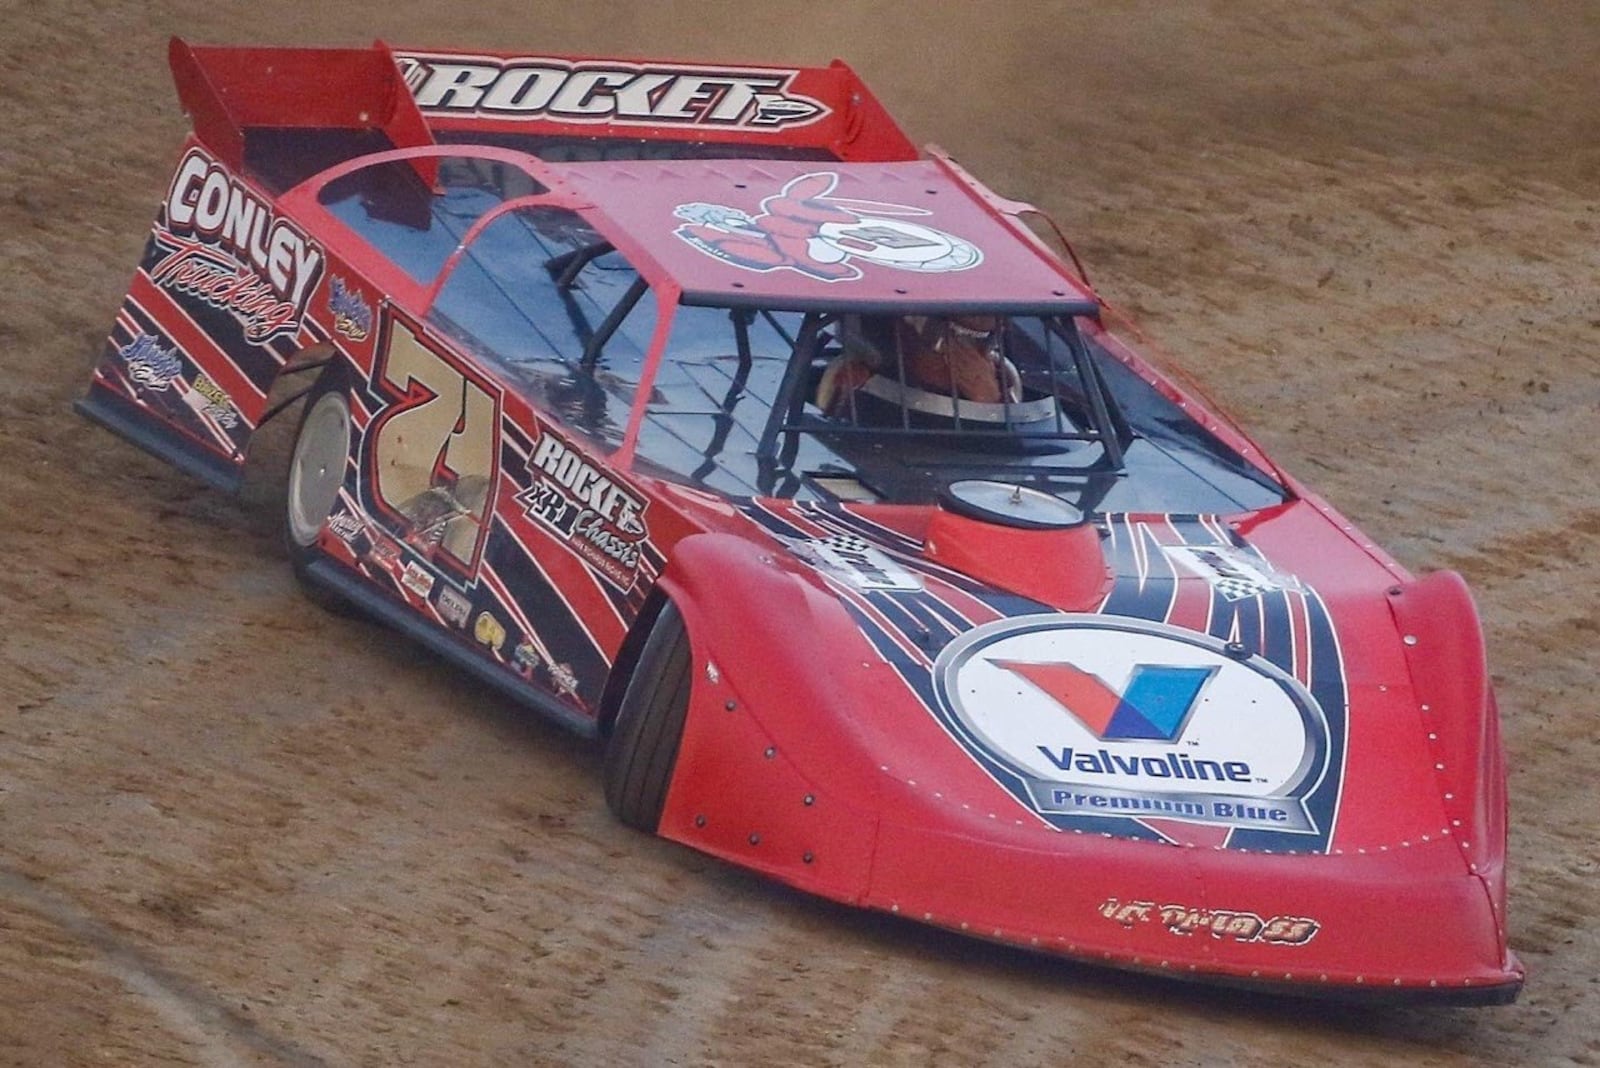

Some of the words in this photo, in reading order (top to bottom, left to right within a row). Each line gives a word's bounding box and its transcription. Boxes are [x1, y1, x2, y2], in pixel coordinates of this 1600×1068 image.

[415, 62, 784, 121] ROCKET
[168, 153, 320, 307] CONLEY
[152, 229, 299, 338] Trucking
[533, 432, 642, 531] ROCKET
[575, 510, 639, 568] Chassis
[1036, 745, 1252, 783] Valvoline
[1052, 789, 1205, 816] Premium
[1213, 802, 1288, 822] Blue
